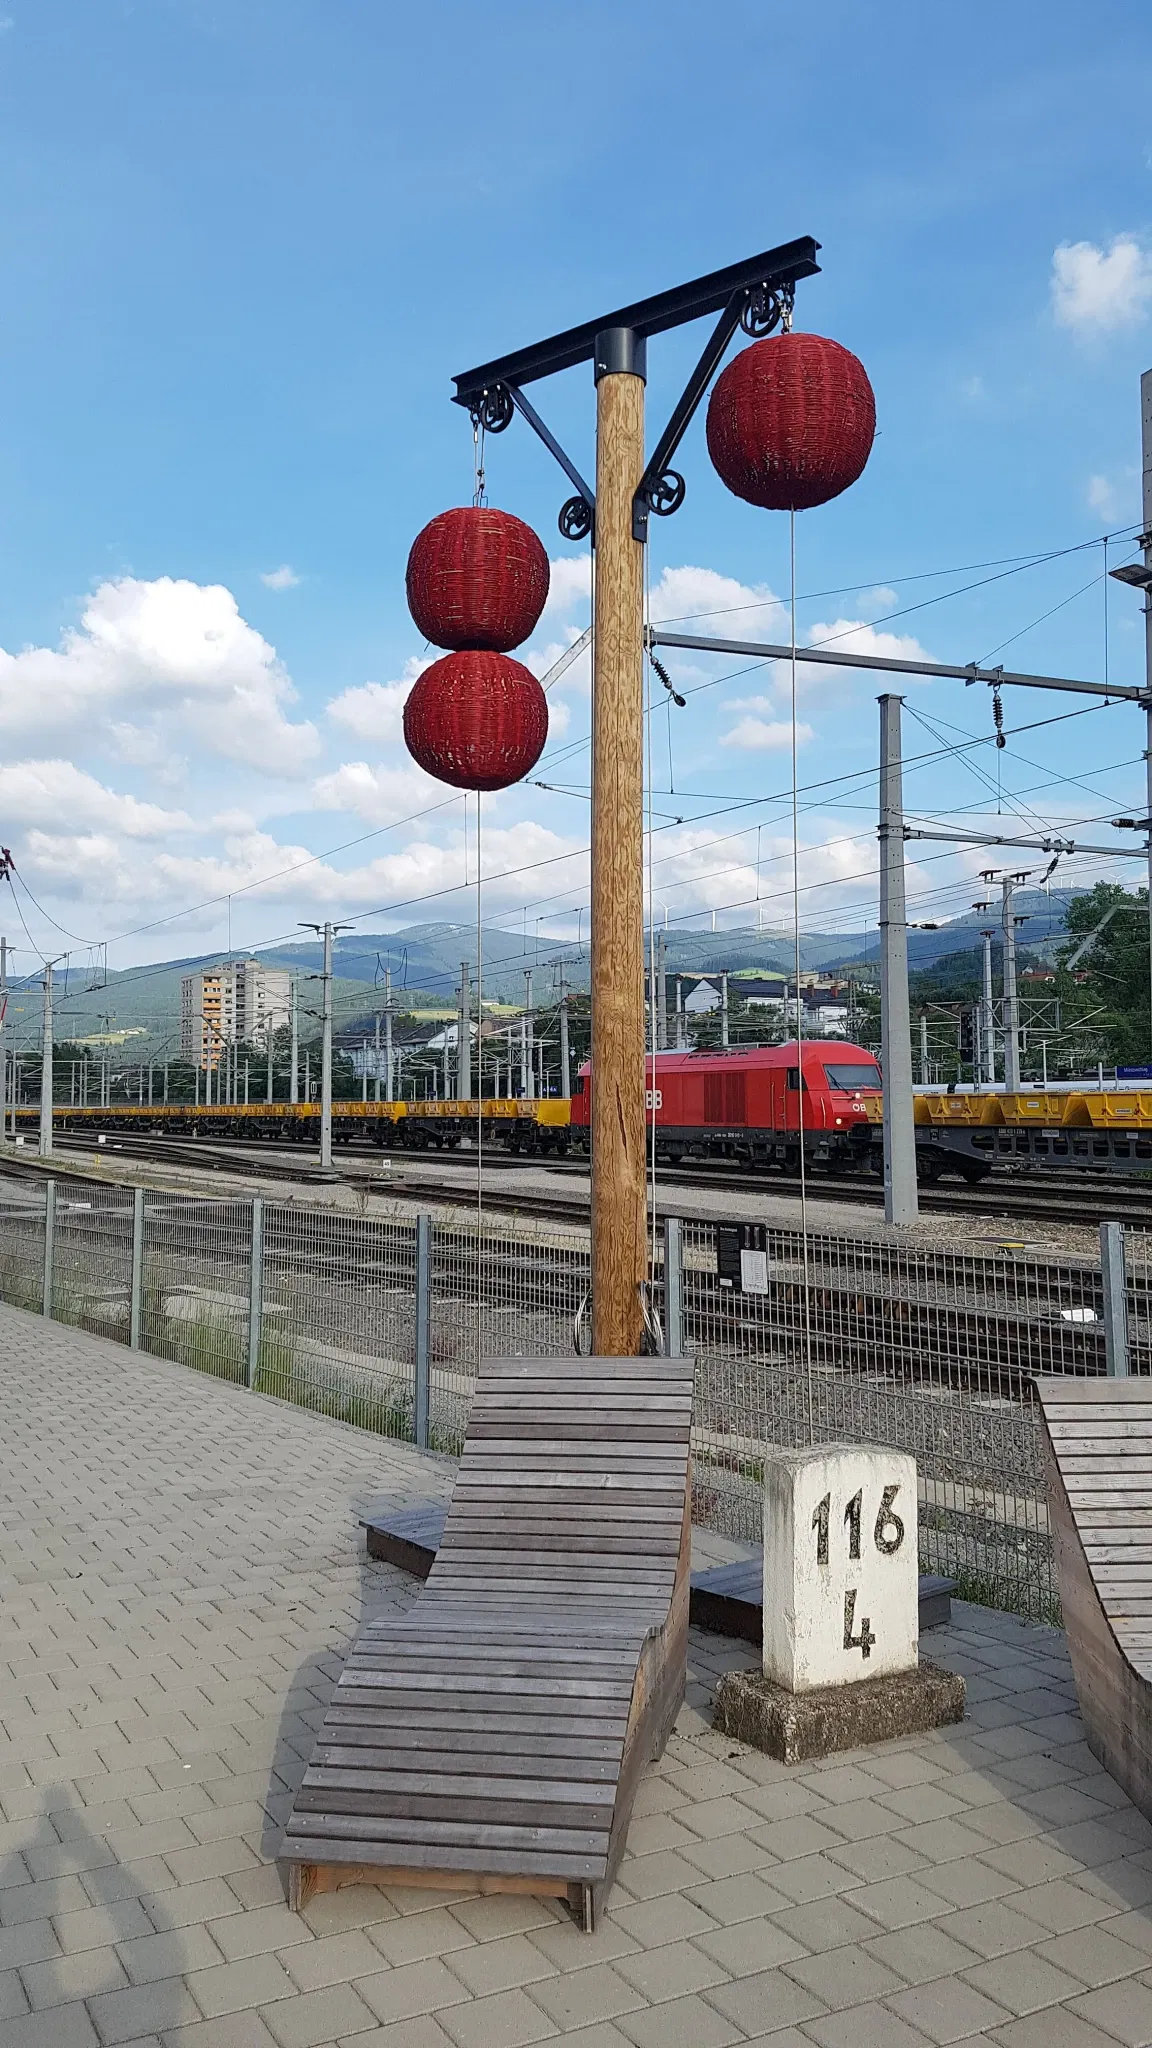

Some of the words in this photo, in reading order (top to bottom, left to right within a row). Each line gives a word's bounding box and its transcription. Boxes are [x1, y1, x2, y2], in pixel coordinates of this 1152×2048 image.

[645, 1089, 663, 1110] BB
[852, 1103, 867, 1112] ÖB
[811, 1484, 905, 1564] 116
[842, 1588, 876, 1659] 4
